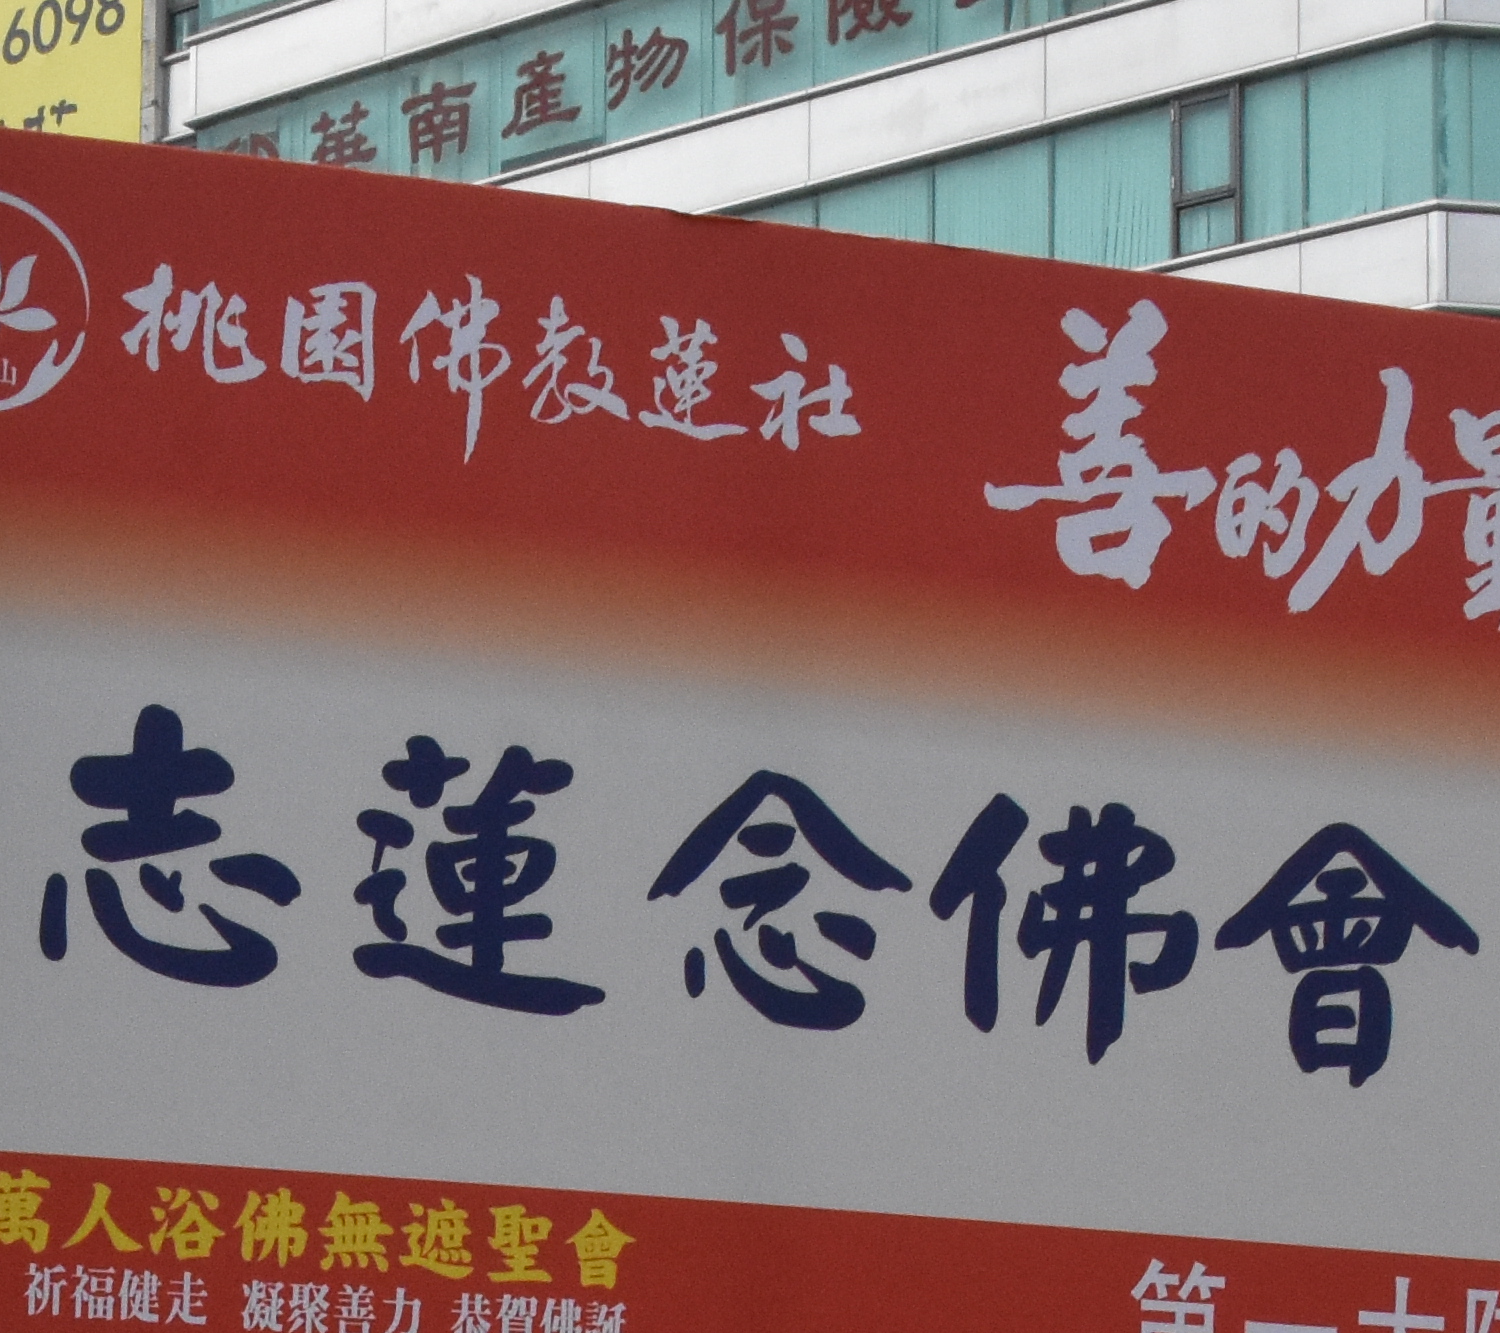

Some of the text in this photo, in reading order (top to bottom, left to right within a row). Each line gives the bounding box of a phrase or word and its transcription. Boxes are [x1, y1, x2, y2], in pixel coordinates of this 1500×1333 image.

[121, 262, 862, 466] 桃園佛教蓮社
[36, 702, 1482, 1090] 志蓮念佛會
[23, 1260, 209, 1329] 祈福健走
